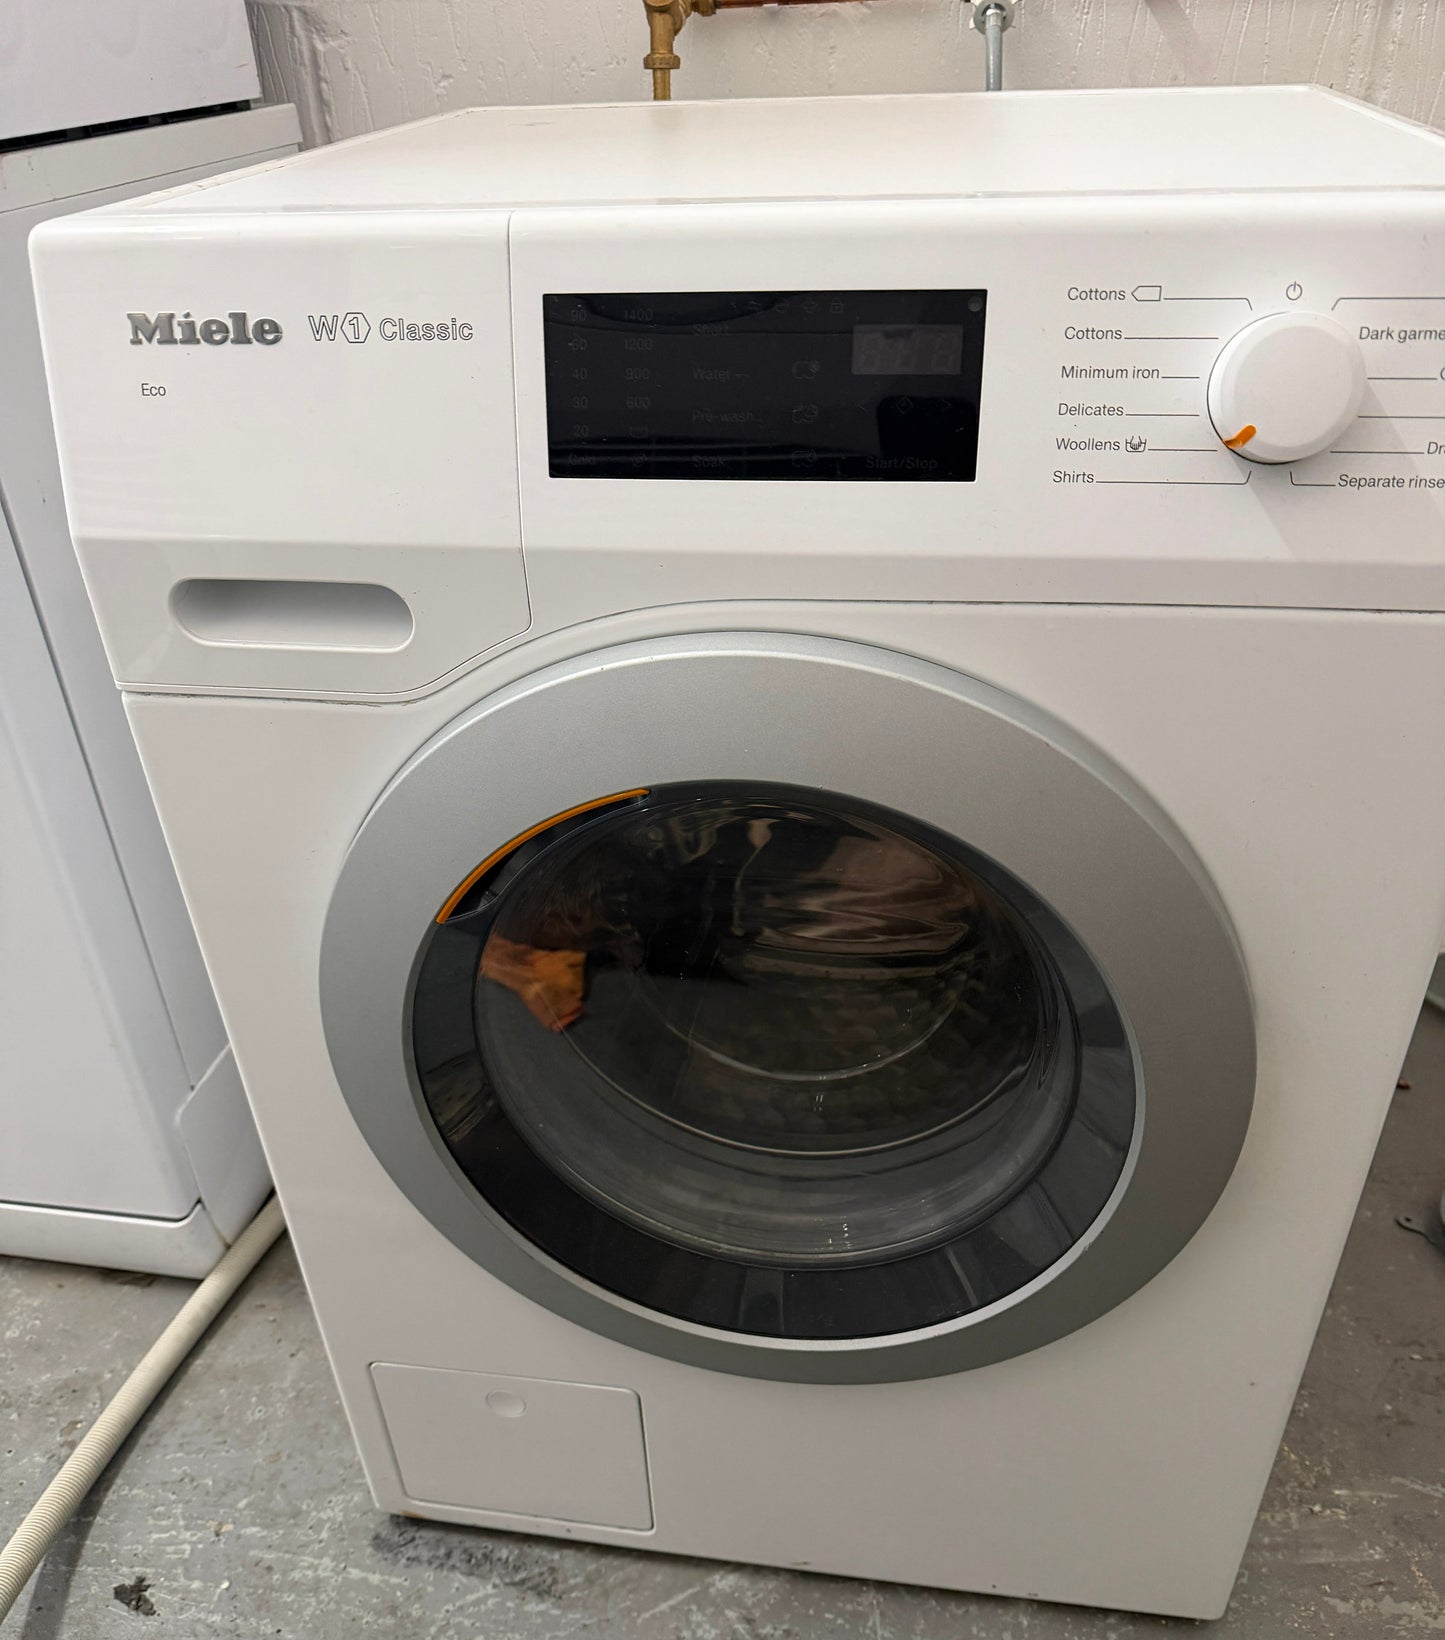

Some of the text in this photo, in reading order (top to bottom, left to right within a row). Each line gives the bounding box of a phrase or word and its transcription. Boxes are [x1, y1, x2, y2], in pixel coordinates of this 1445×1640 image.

[1067, 287, 1126, 301] Cottons
[623, 308, 653, 321] 1400
[126, 311, 284, 345] Miele
[379, 317, 474, 342] Classic
[1064, 326, 1123, 340] Cottons
[1359, 326, 1394, 340] Dark
[623, 338, 653, 351] 1200
[625, 367, 650, 380] 900
[691, 366, 730, 381] Water
[1060, 366, 1160, 379] Minimum iron
[141, 382, 167, 397] Eco
[1058, 403, 1124, 417] Delicates
[1055, 437, 1121, 451] Woollens
[1427, 441, 1445, 455] Dr
[865, 455, 939, 471] Start/Stop
[1052, 470, 1095, 484] Shirts
[1338, 473, 1445, 490] Separate rinse
